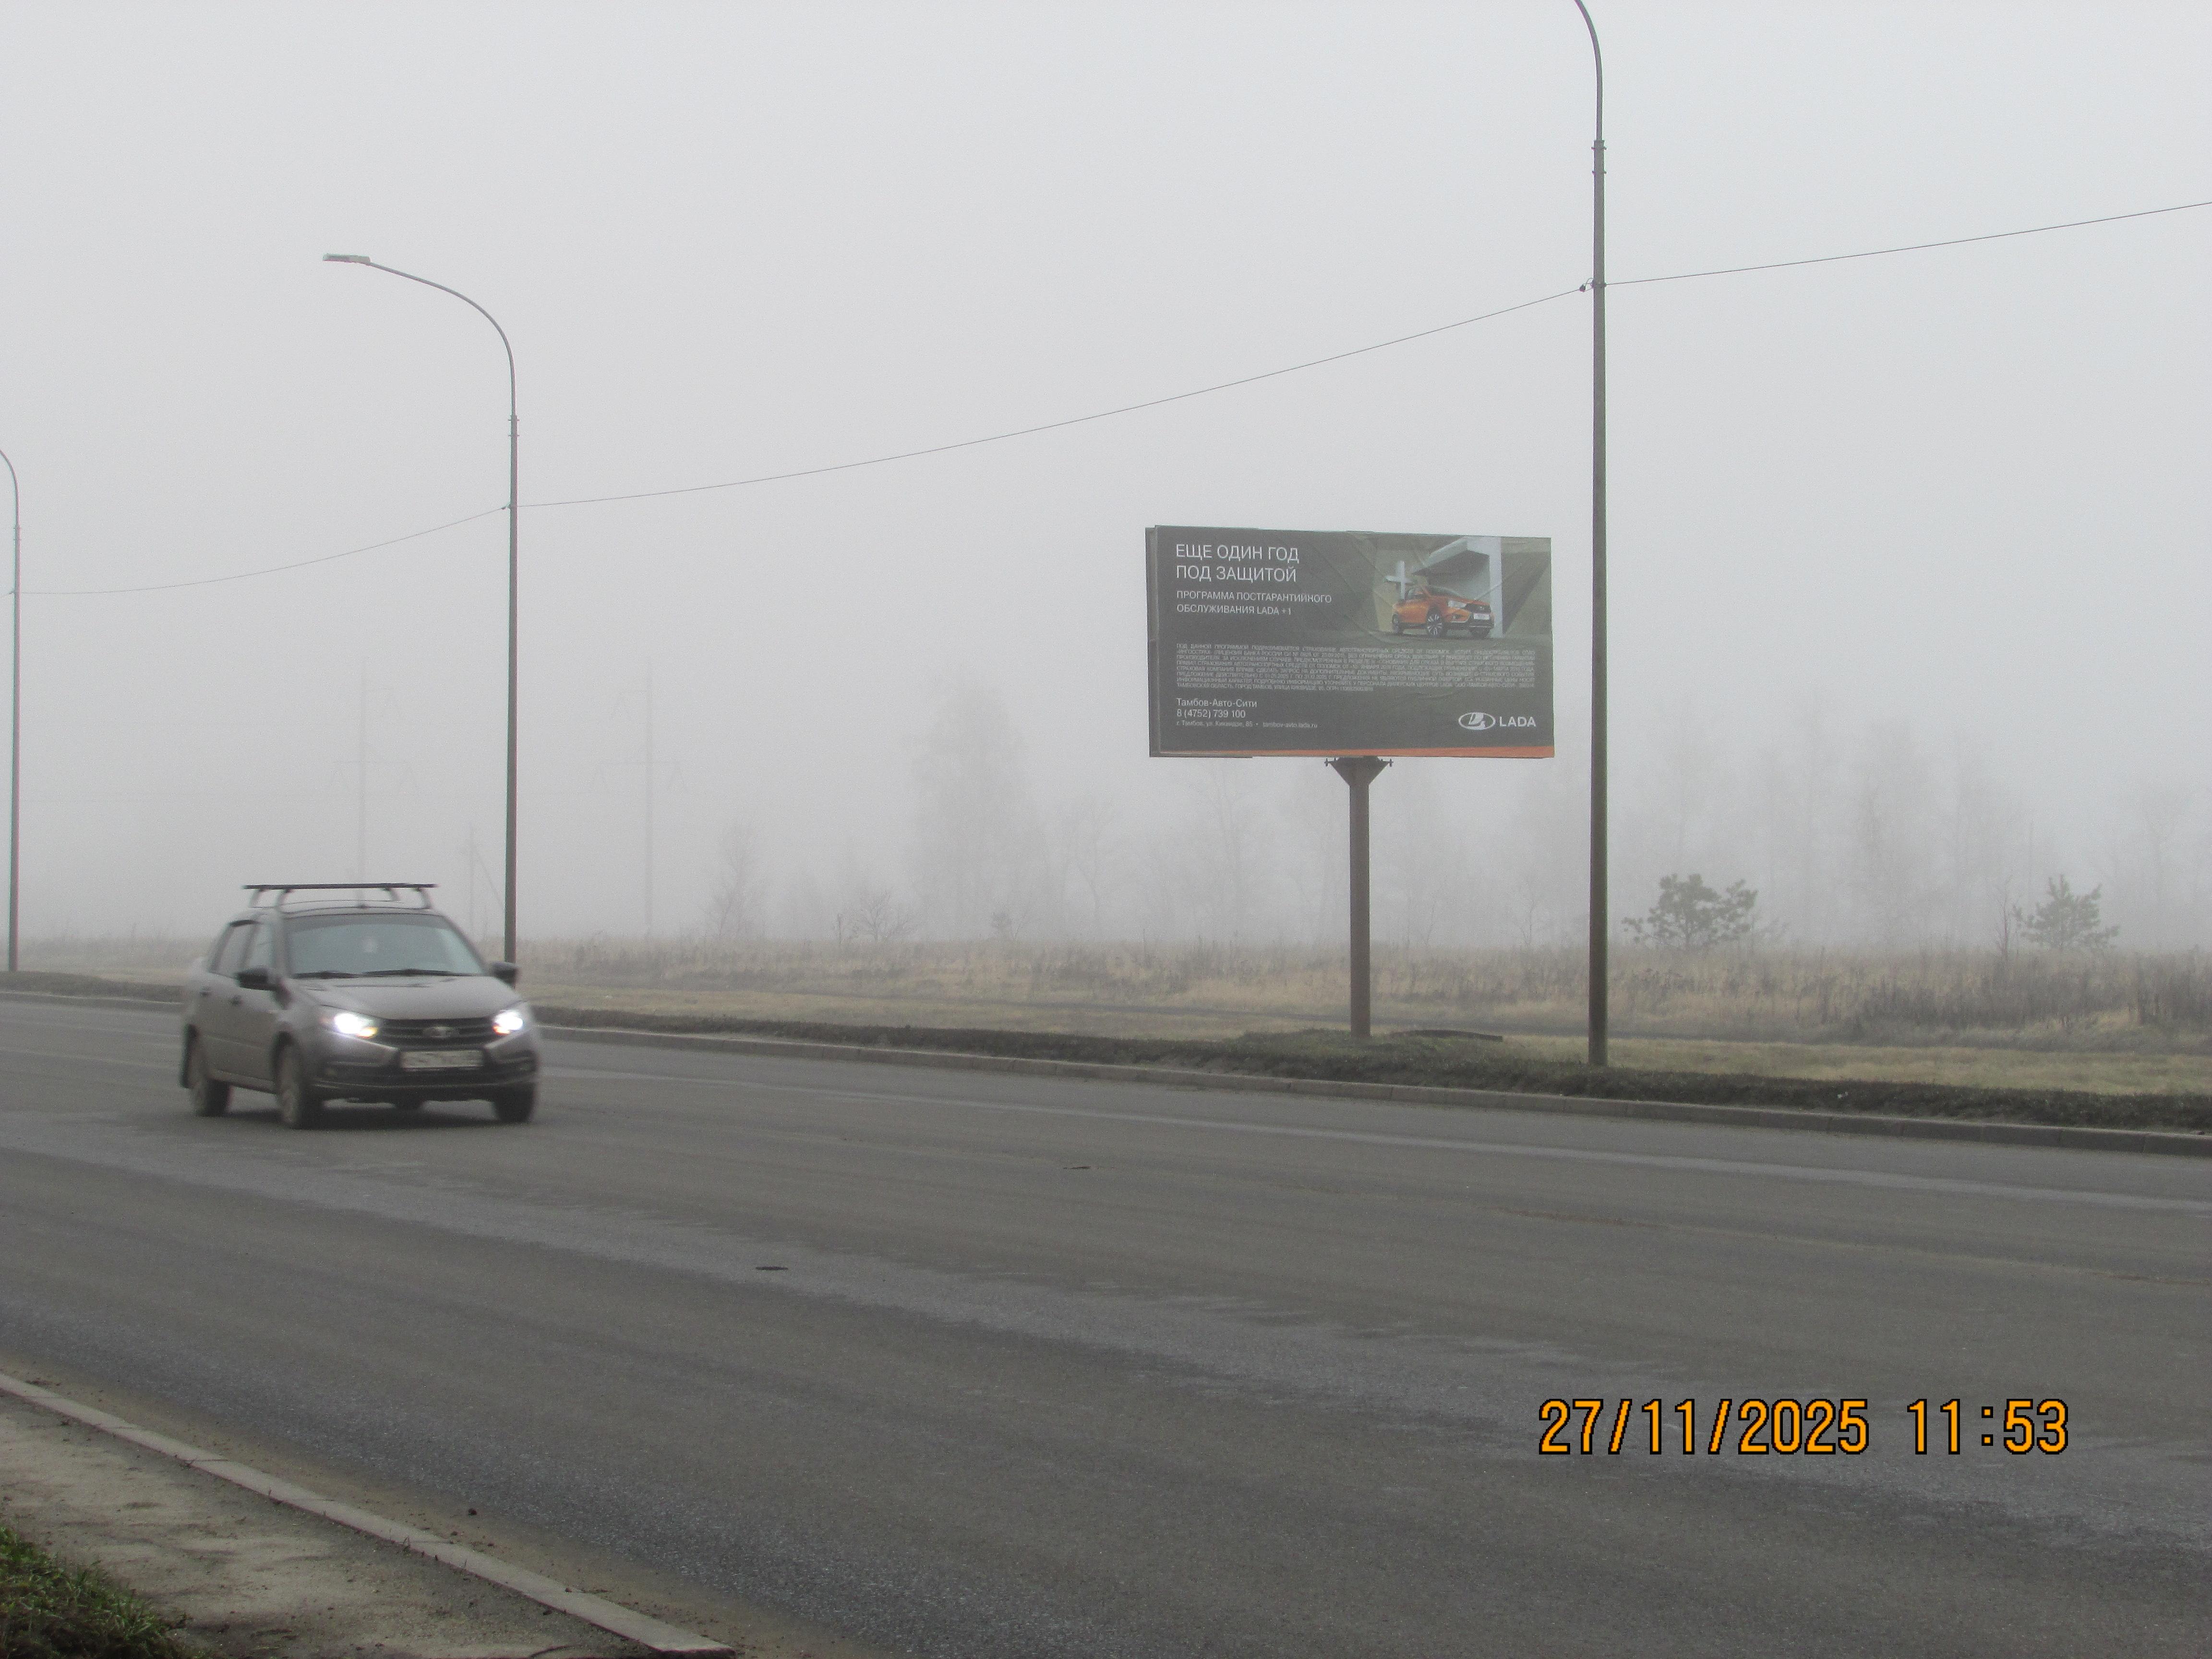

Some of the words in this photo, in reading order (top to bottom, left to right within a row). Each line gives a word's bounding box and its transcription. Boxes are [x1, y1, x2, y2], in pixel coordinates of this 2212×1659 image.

[1176, 544, 1213, 561] ЕЩЕ
[1217, 545, 1263, 562] ОДИН
[1268, 546, 1300, 564] ГОД
[1176, 565, 1212, 581] ПОД
[1216, 565, 1297, 583] ЗАЩИТОЙ
[1177, 590, 1235, 601] ПРОГРАММА
[1237, 591, 1332, 603] ПОСТГАРАНТИЙНОГО
[1177, 603, 1254, 614] ОБСЛУЖИВАНИЯ
[1257, 607, 1280, 615] LADA
[1177, 698, 1257, 708] Тамбов-Авто-Сити
[1184, 709, 1211, 719] (4752)
[1213, 709, 1228, 718] 739
[1232, 710, 1245, 718] 100
[1499, 716, 1537, 727] LADA
